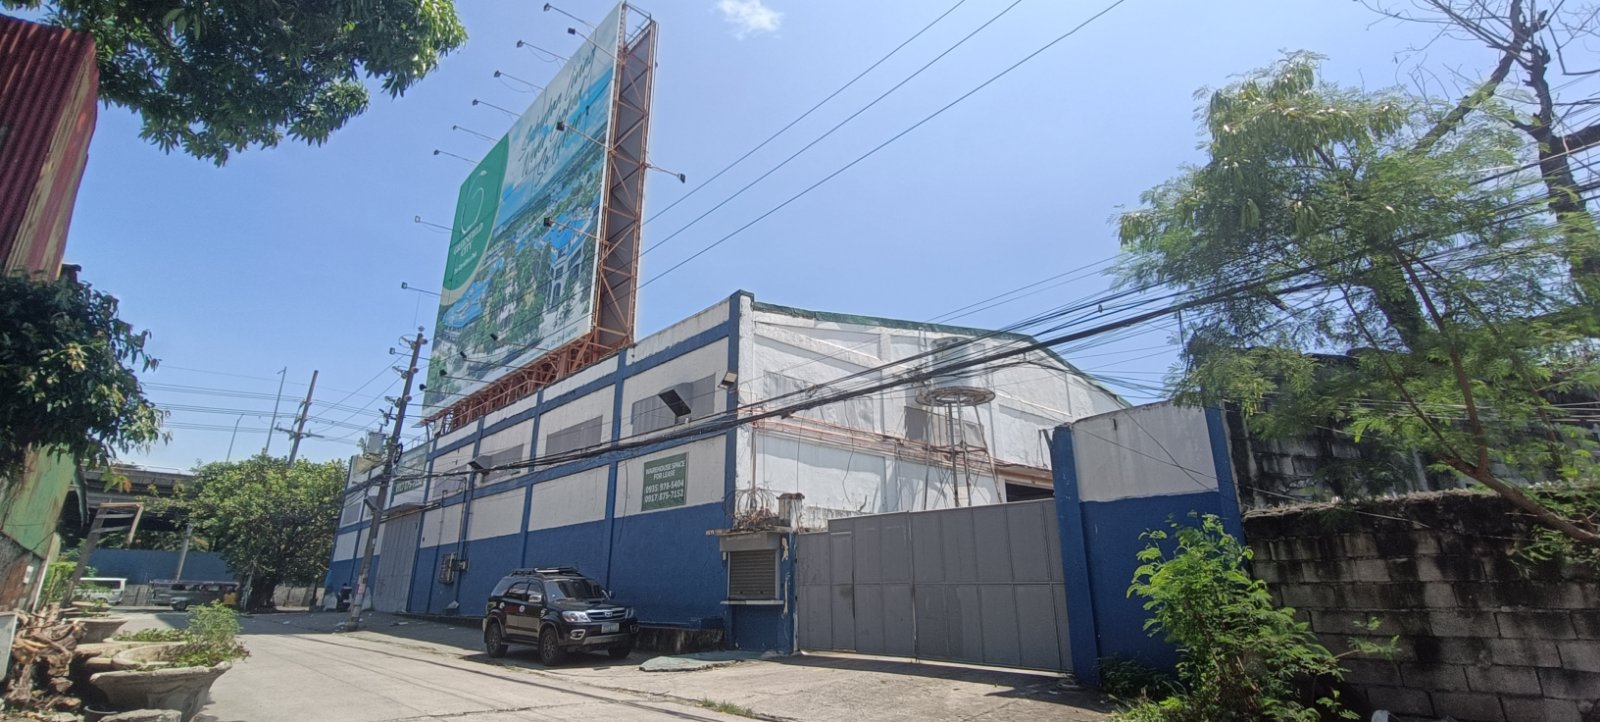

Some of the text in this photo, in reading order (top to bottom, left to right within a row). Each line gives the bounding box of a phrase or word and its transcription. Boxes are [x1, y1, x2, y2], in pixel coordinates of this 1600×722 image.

[646, 463, 671, 475] WAREHOUSE
[653, 469, 676, 481] FOR LEASE
